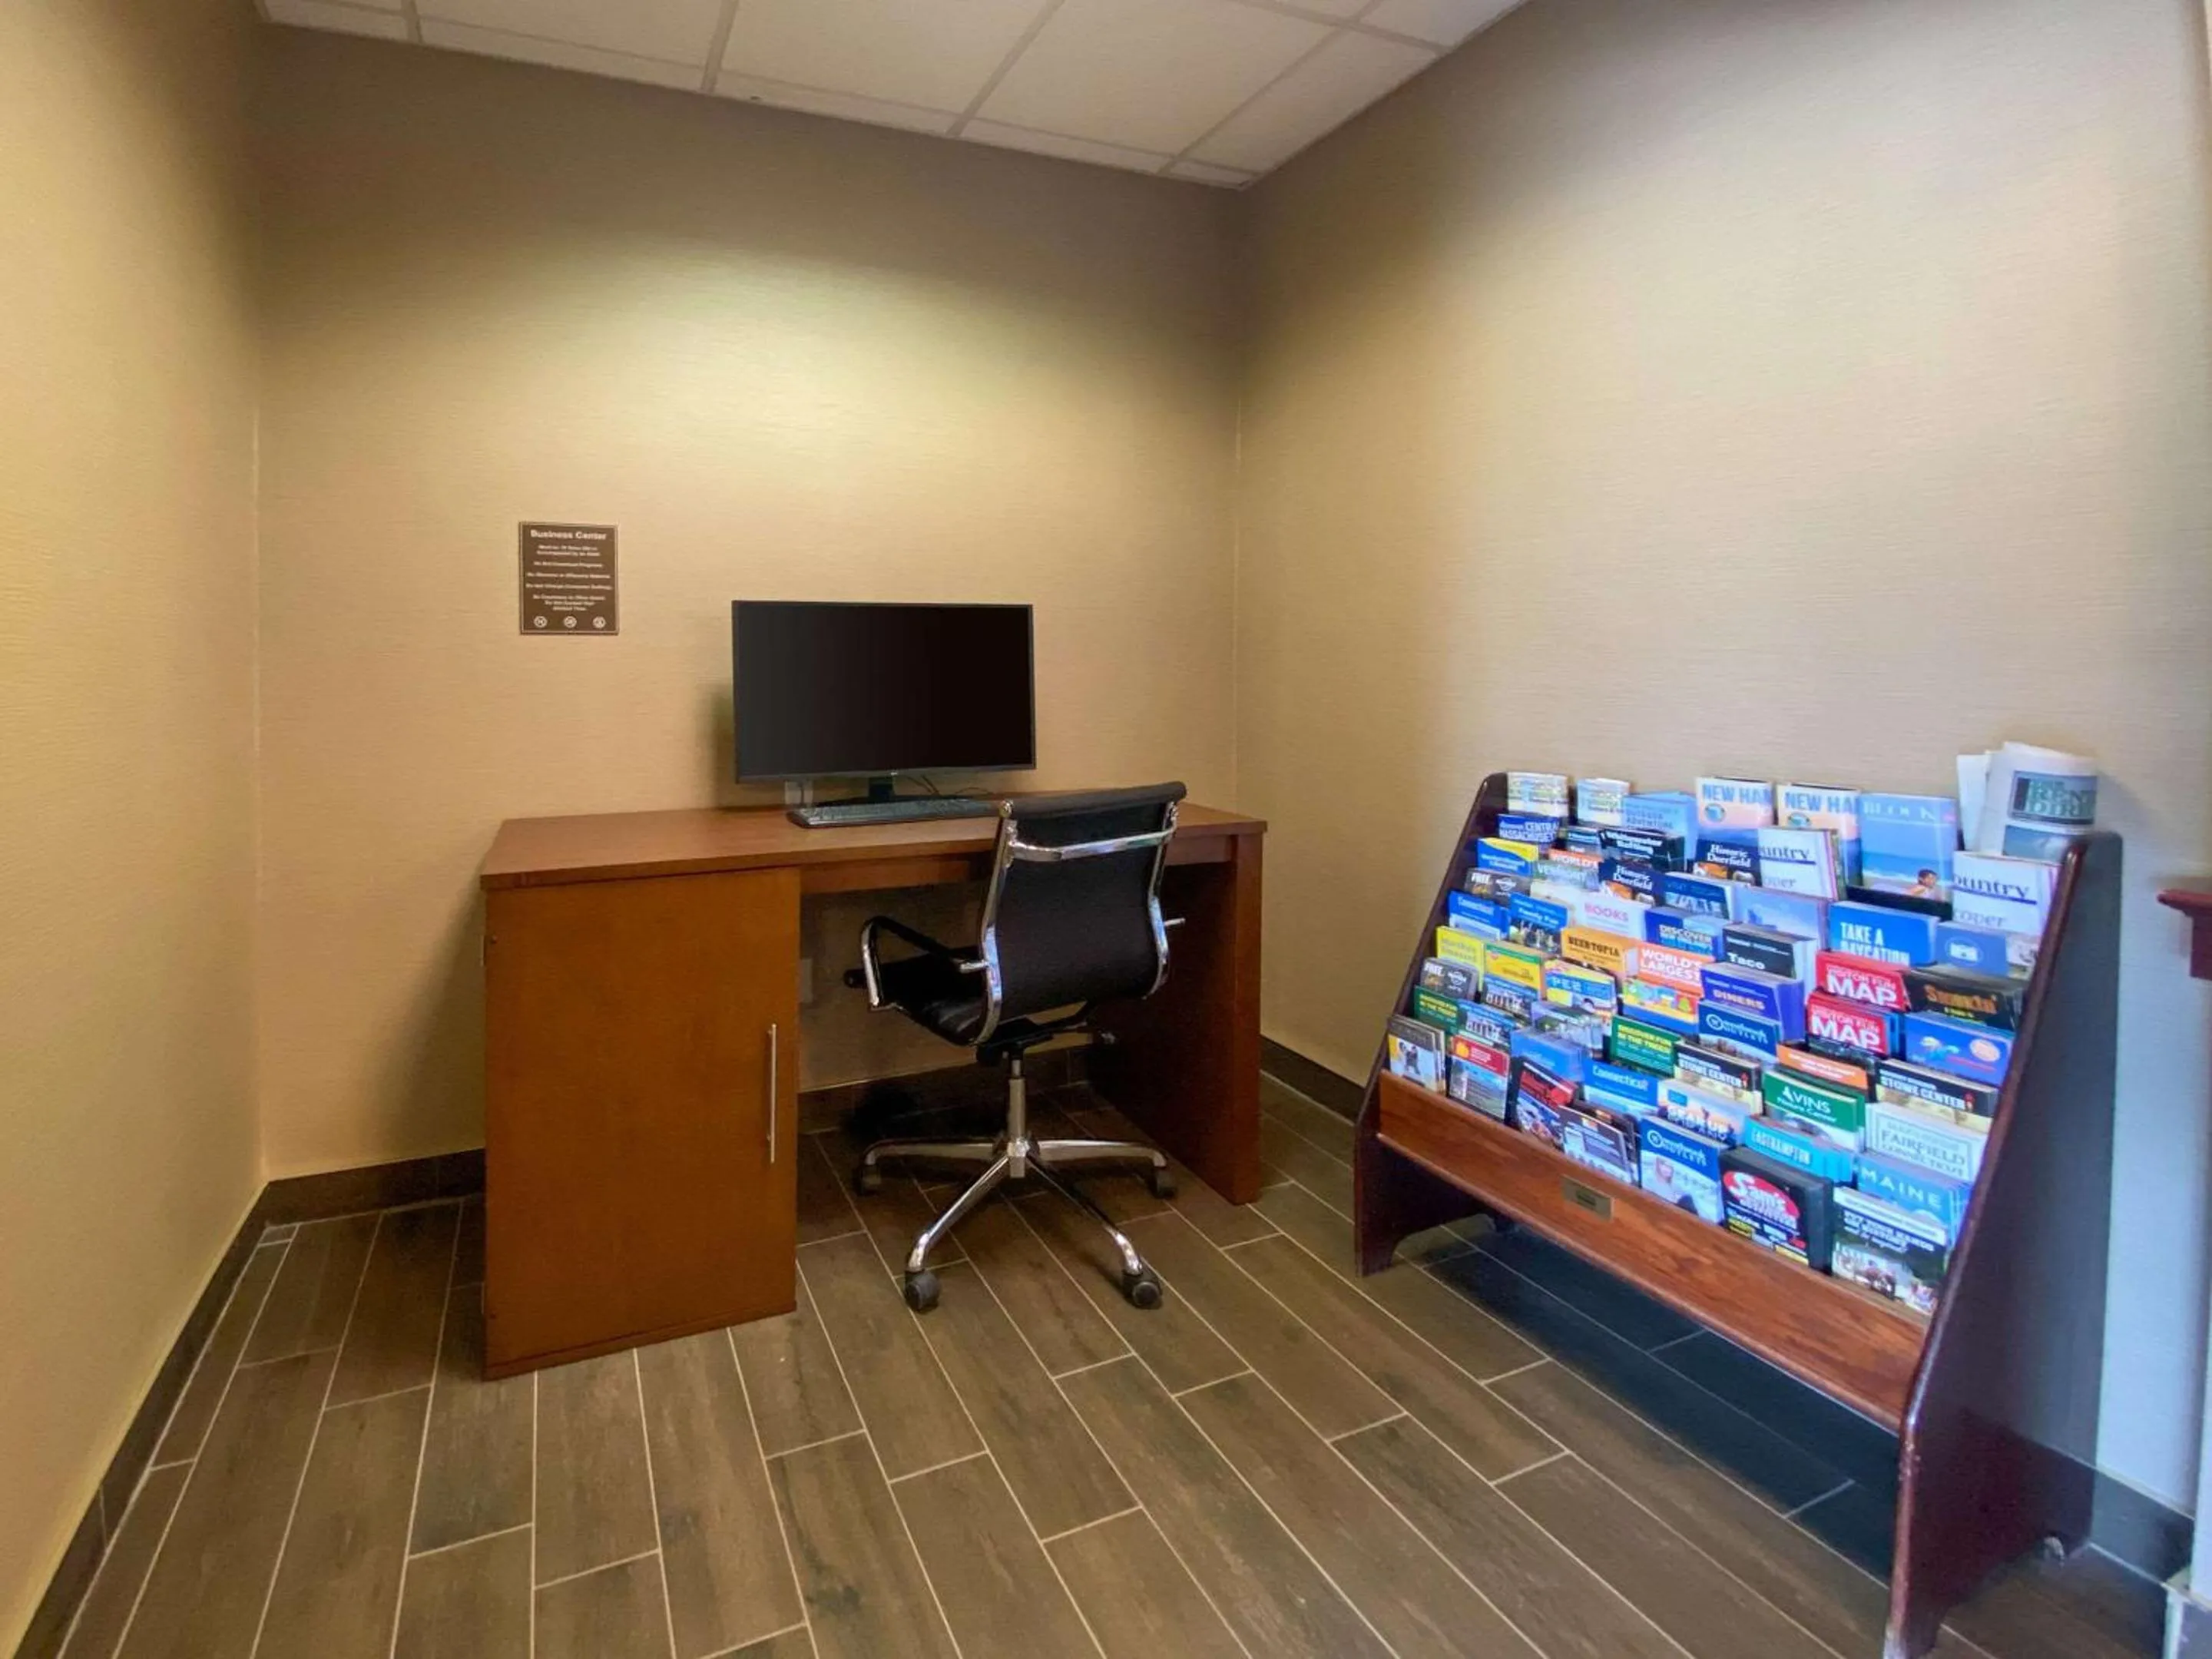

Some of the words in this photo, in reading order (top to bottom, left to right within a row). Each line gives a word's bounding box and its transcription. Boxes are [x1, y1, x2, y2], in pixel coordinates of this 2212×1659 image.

[530, 529, 573, 538] Business
[575, 531, 607, 540] Center
[1702, 784, 1734, 802] NEW
[1784, 792, 1820, 812] NEW
[1707, 853, 1751, 867] Deerfield
[1760, 844, 1810, 860] untry
[1955, 873, 2030, 898] ountry
[1584, 902, 1629, 921] BOOKS
[1840, 922, 1872, 941] TAKE
[1874, 928, 1885, 946] A
[1726, 952, 1766, 970] Taco
[1827, 973, 1897, 1008] MAP
[1811, 1015, 1881, 1049] MAP
[1592, 1065, 1649, 1091] Connecticut
[1708, 1068, 1743, 1088] CENTER
[1920, 1088, 1965, 1110] CENTER
[1882, 1130, 1965, 1167] FAIRFIELD
[1727, 1170, 1787, 1206] Sam's
[1861, 1167, 1942, 1209] MAINE
